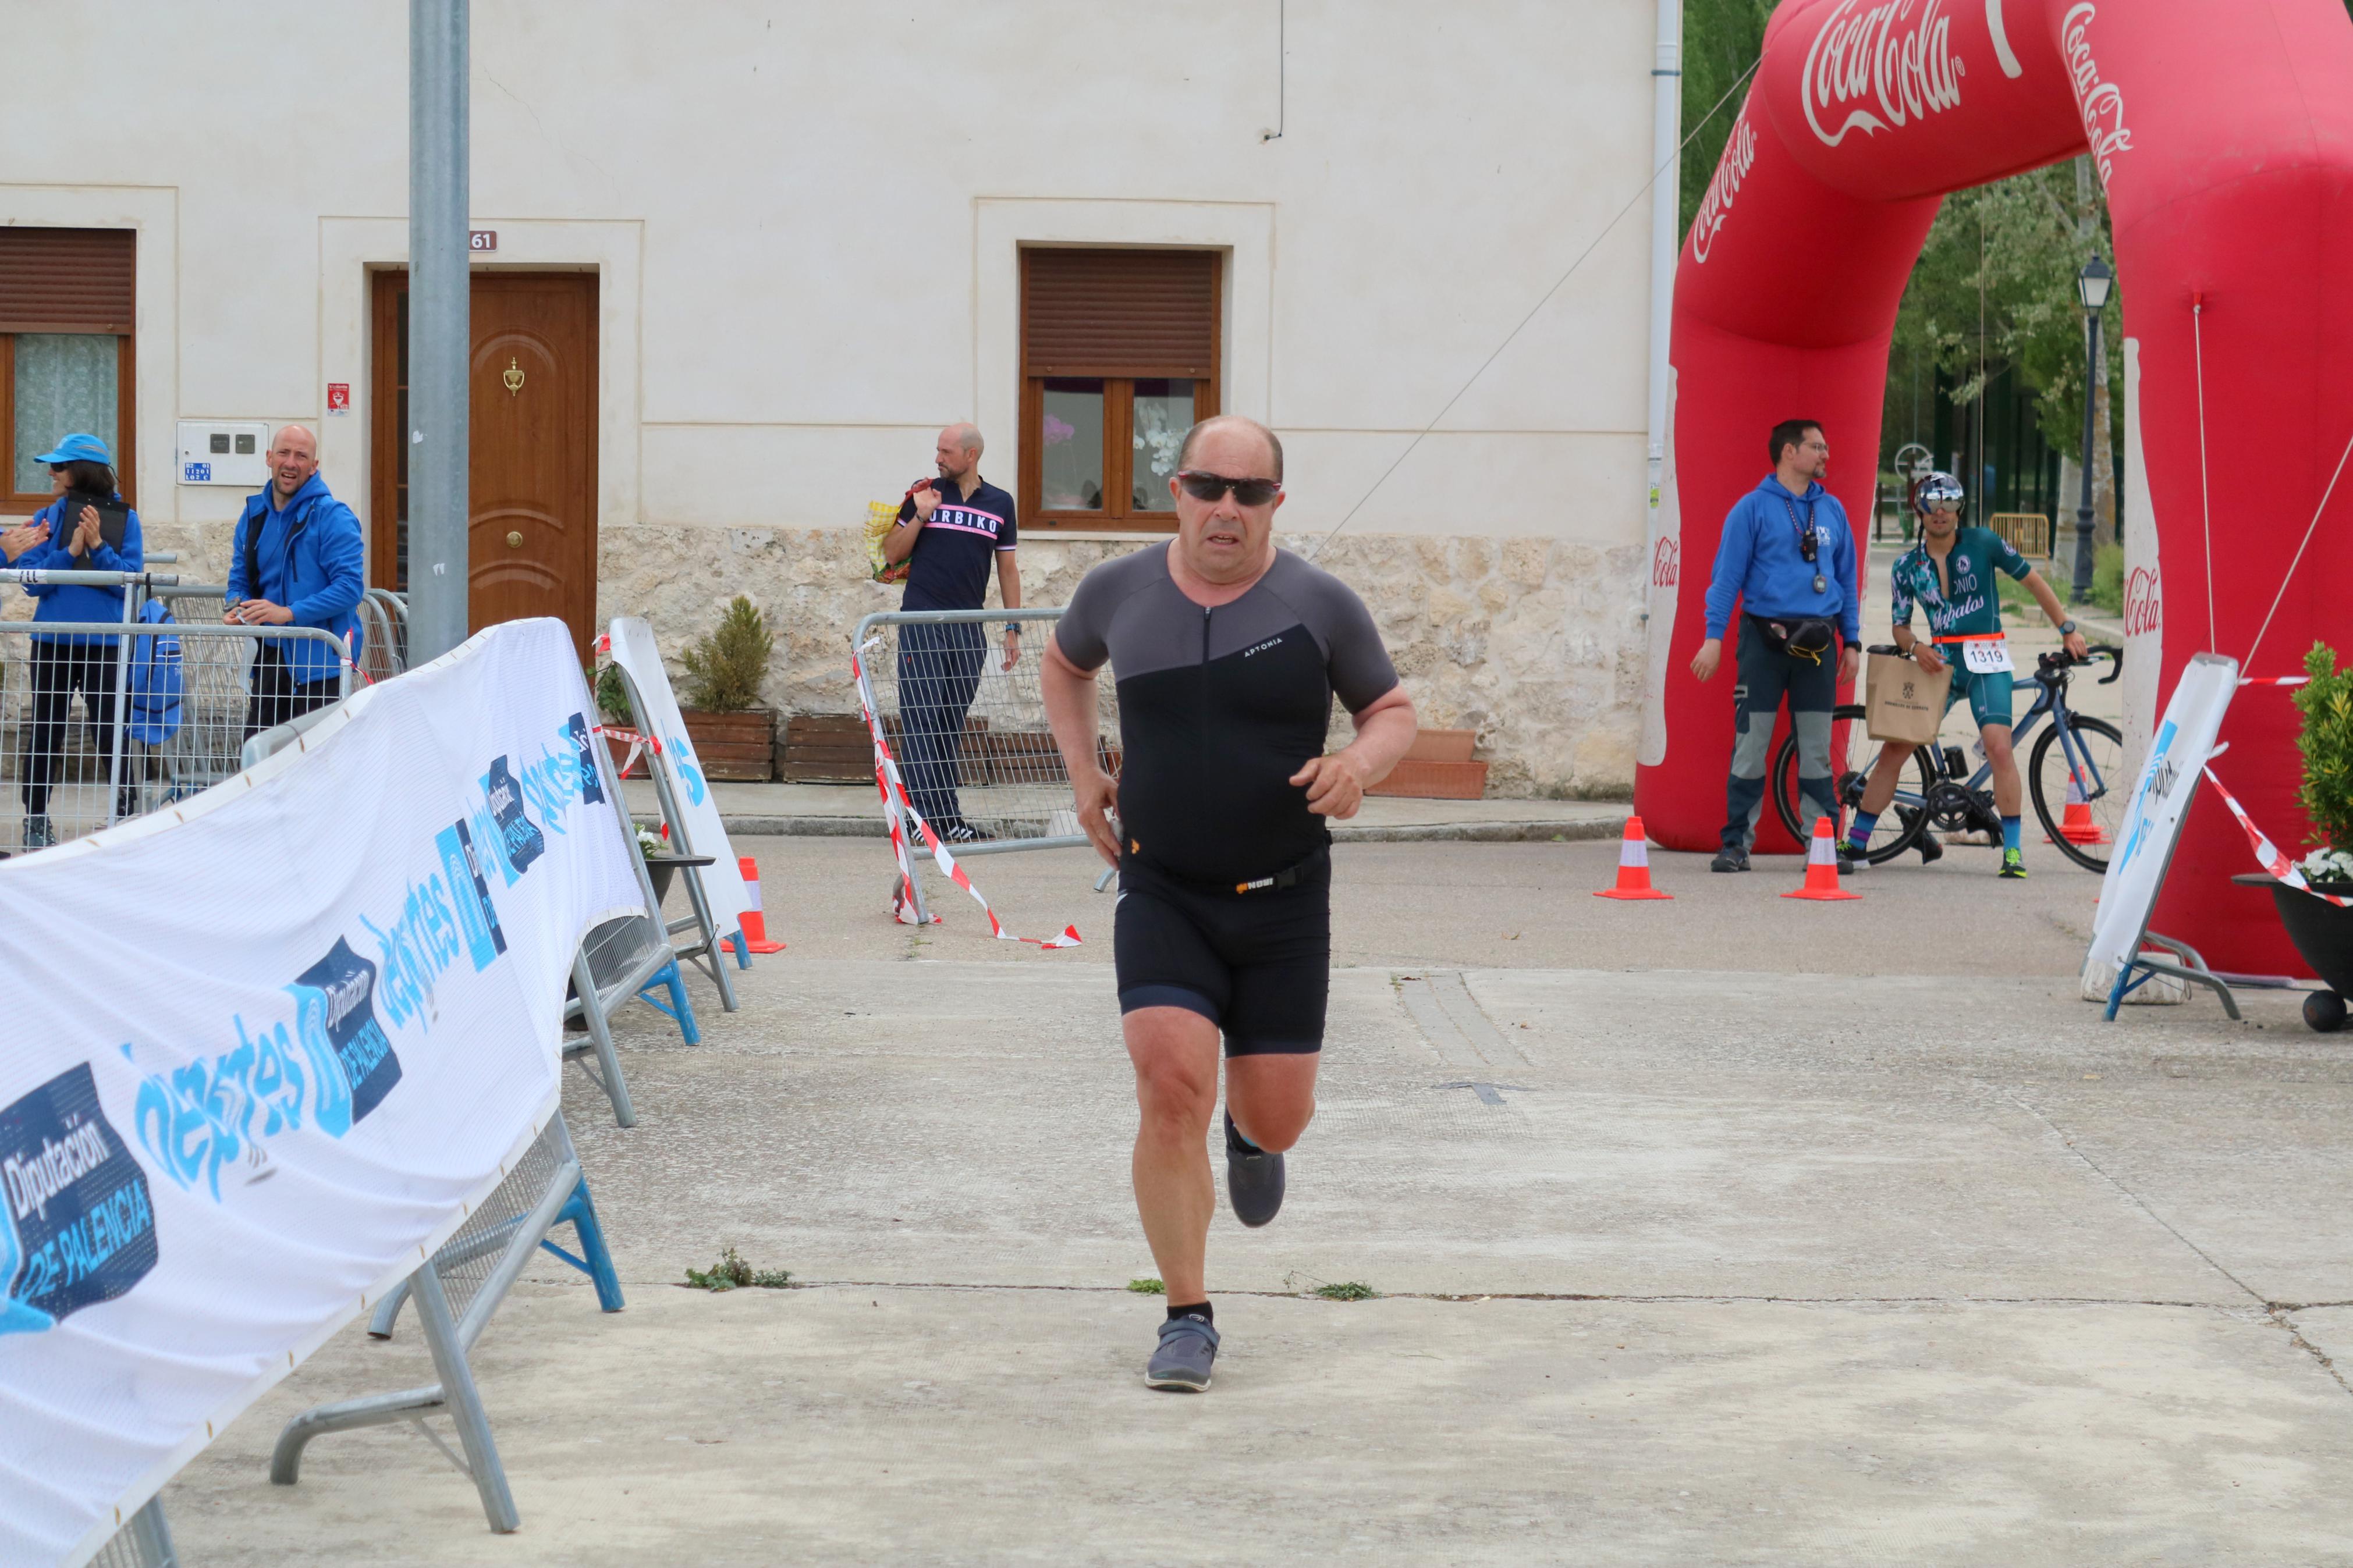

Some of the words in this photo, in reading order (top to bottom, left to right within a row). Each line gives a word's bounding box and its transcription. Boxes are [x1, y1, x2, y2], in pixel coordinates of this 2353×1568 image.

[471, 233, 490, 248] 61
[1245, 638, 1283, 658] APTONIA
[1971, 650, 2003, 663] 1319
[5, 1113, 111, 1221] Diputación
[58, 1179, 151, 1287] PALENCIA
